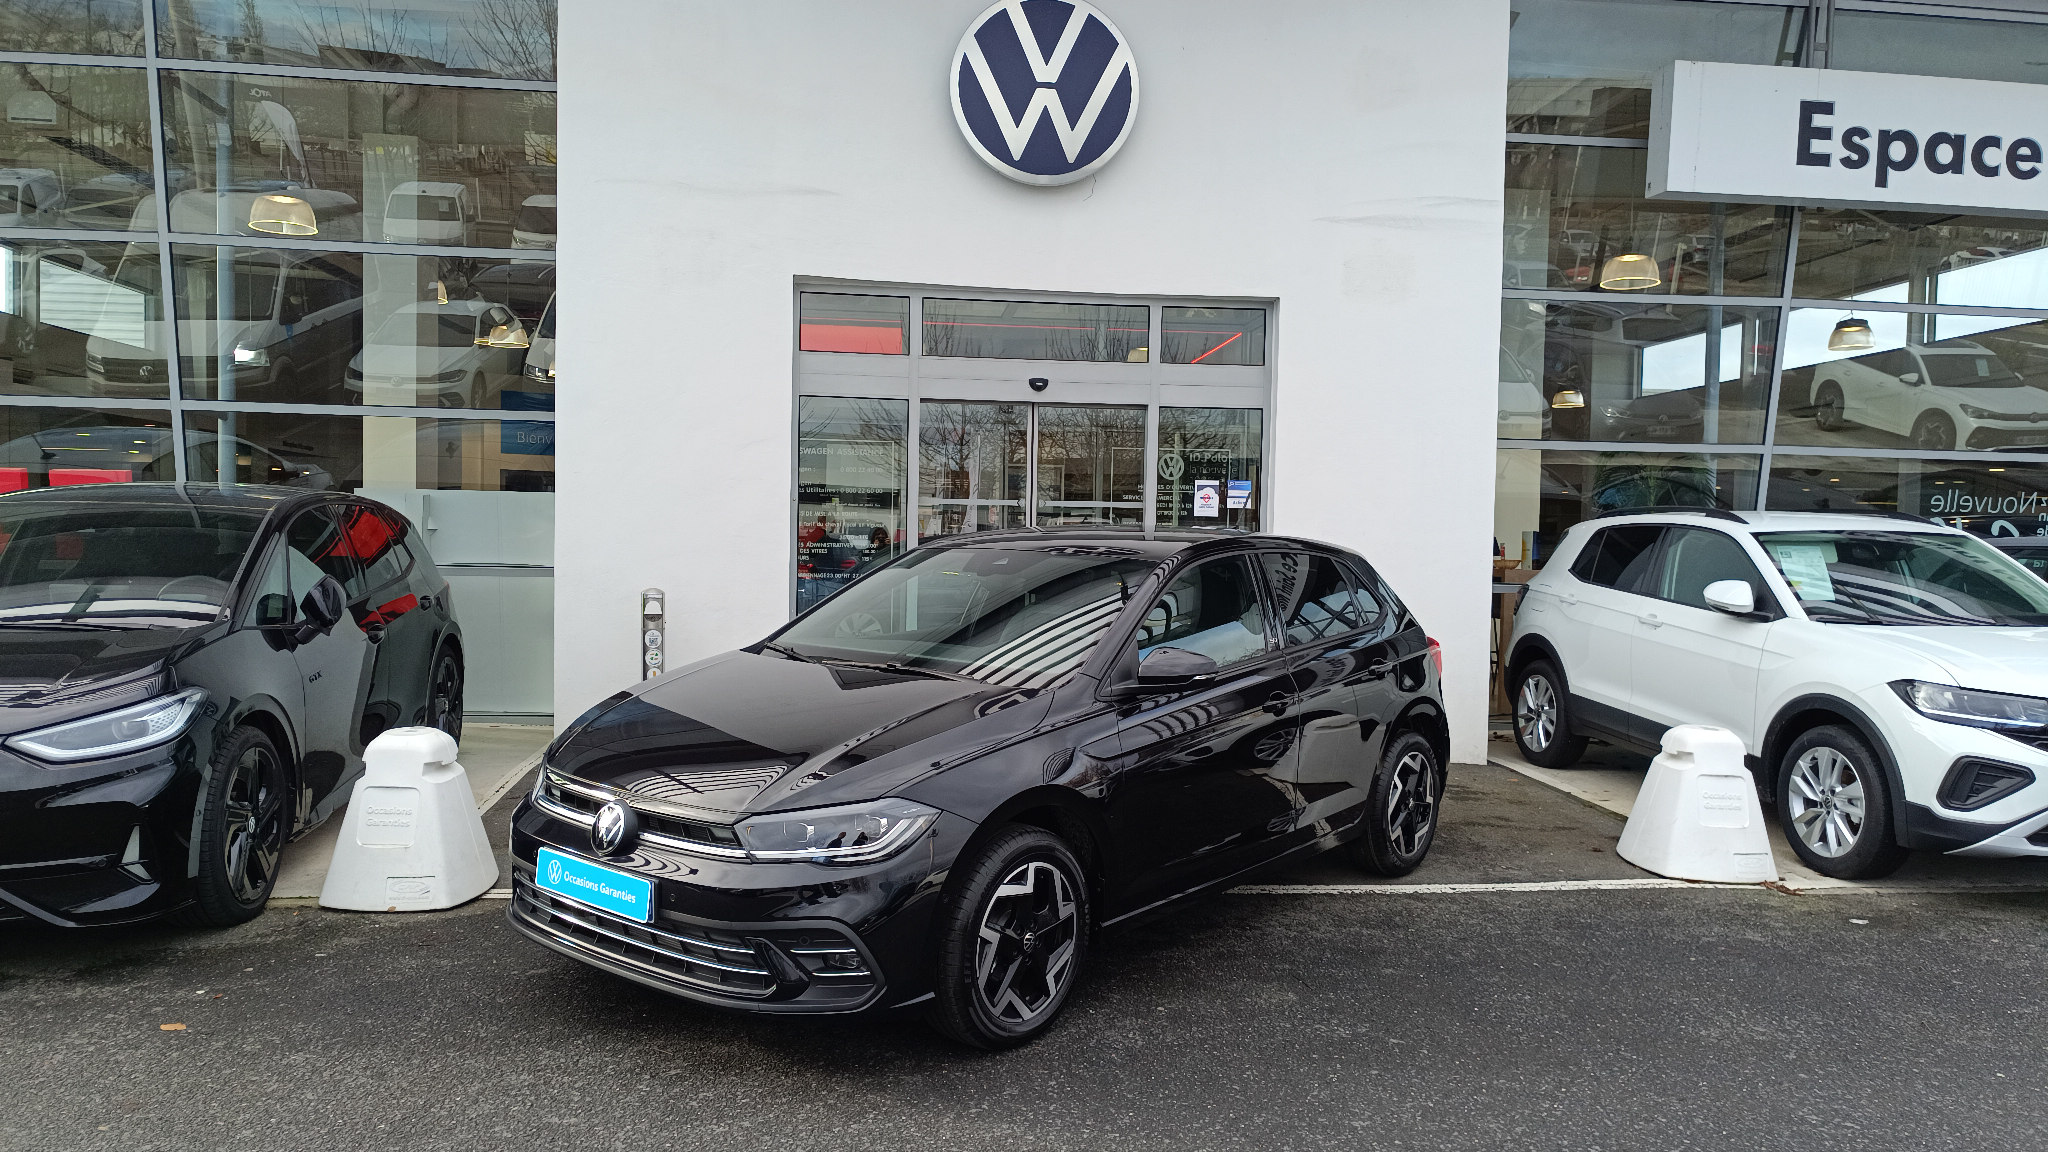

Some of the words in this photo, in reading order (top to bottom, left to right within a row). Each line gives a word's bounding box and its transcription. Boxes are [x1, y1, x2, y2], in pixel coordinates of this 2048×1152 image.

[1796, 100, 2044, 189] Espace
[517, 431, 554, 445] Bienv
[837, 448, 884, 457] ASSISTANCE
[366, 806, 413, 816] Occasions
[365, 818, 411, 828] Garanties
[563, 870, 599, 892] Occasions
[599, 882, 637, 904] Garanties
